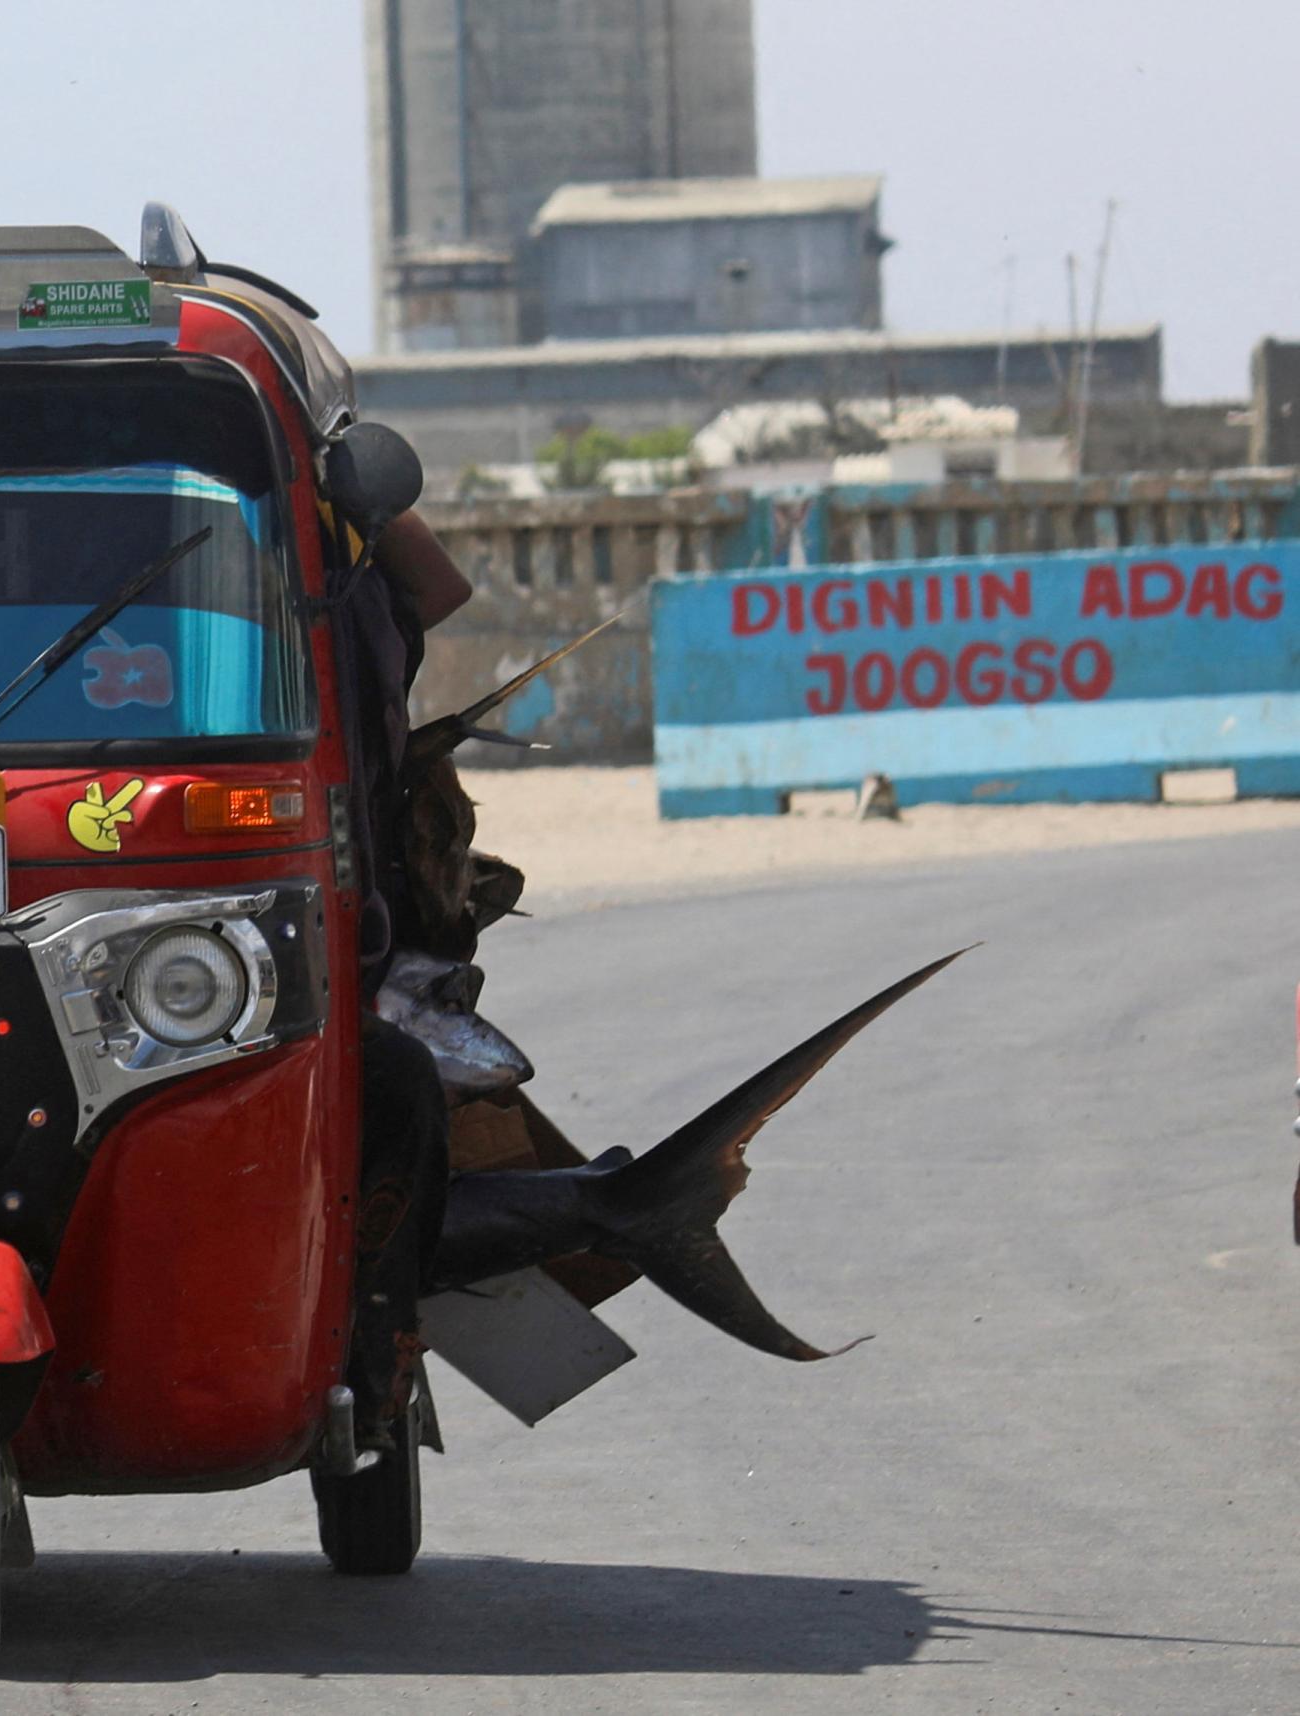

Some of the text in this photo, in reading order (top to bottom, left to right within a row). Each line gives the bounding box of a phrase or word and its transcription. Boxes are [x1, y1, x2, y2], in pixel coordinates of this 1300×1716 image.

[46, 283, 125, 301] SHIDANE
[50, 303, 123, 316] SPARE PARTS
[731, 561, 1285, 637] DIGNIIN ADAG
[806, 638, 1115, 717] JOOGSO
